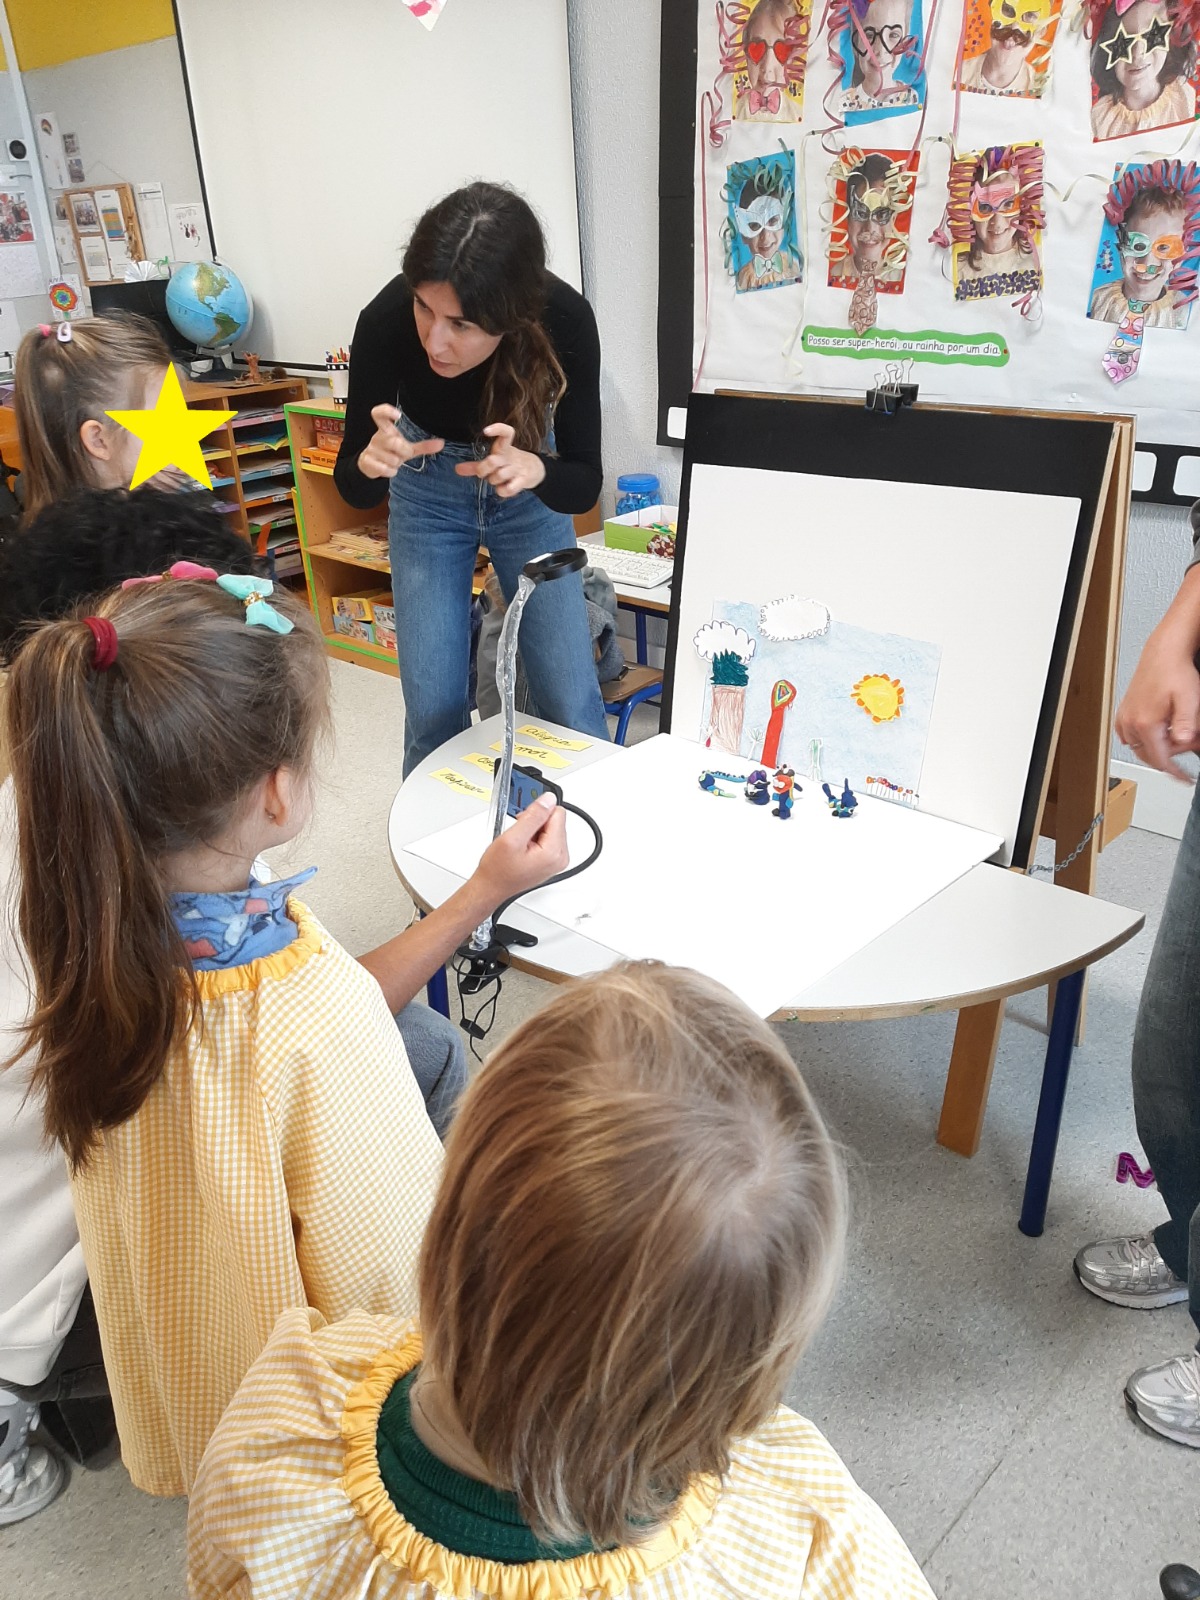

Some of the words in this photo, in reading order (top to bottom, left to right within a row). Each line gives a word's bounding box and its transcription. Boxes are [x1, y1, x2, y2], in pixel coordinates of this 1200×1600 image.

[848, 336, 900, 350] super-herói,
[902, 342, 913, 350] ou
[915, 341, 945, 351] rainha
[947, 344, 964, 354] por
[966, 346, 980, 354] um
[983, 344, 1001, 355] dia.
